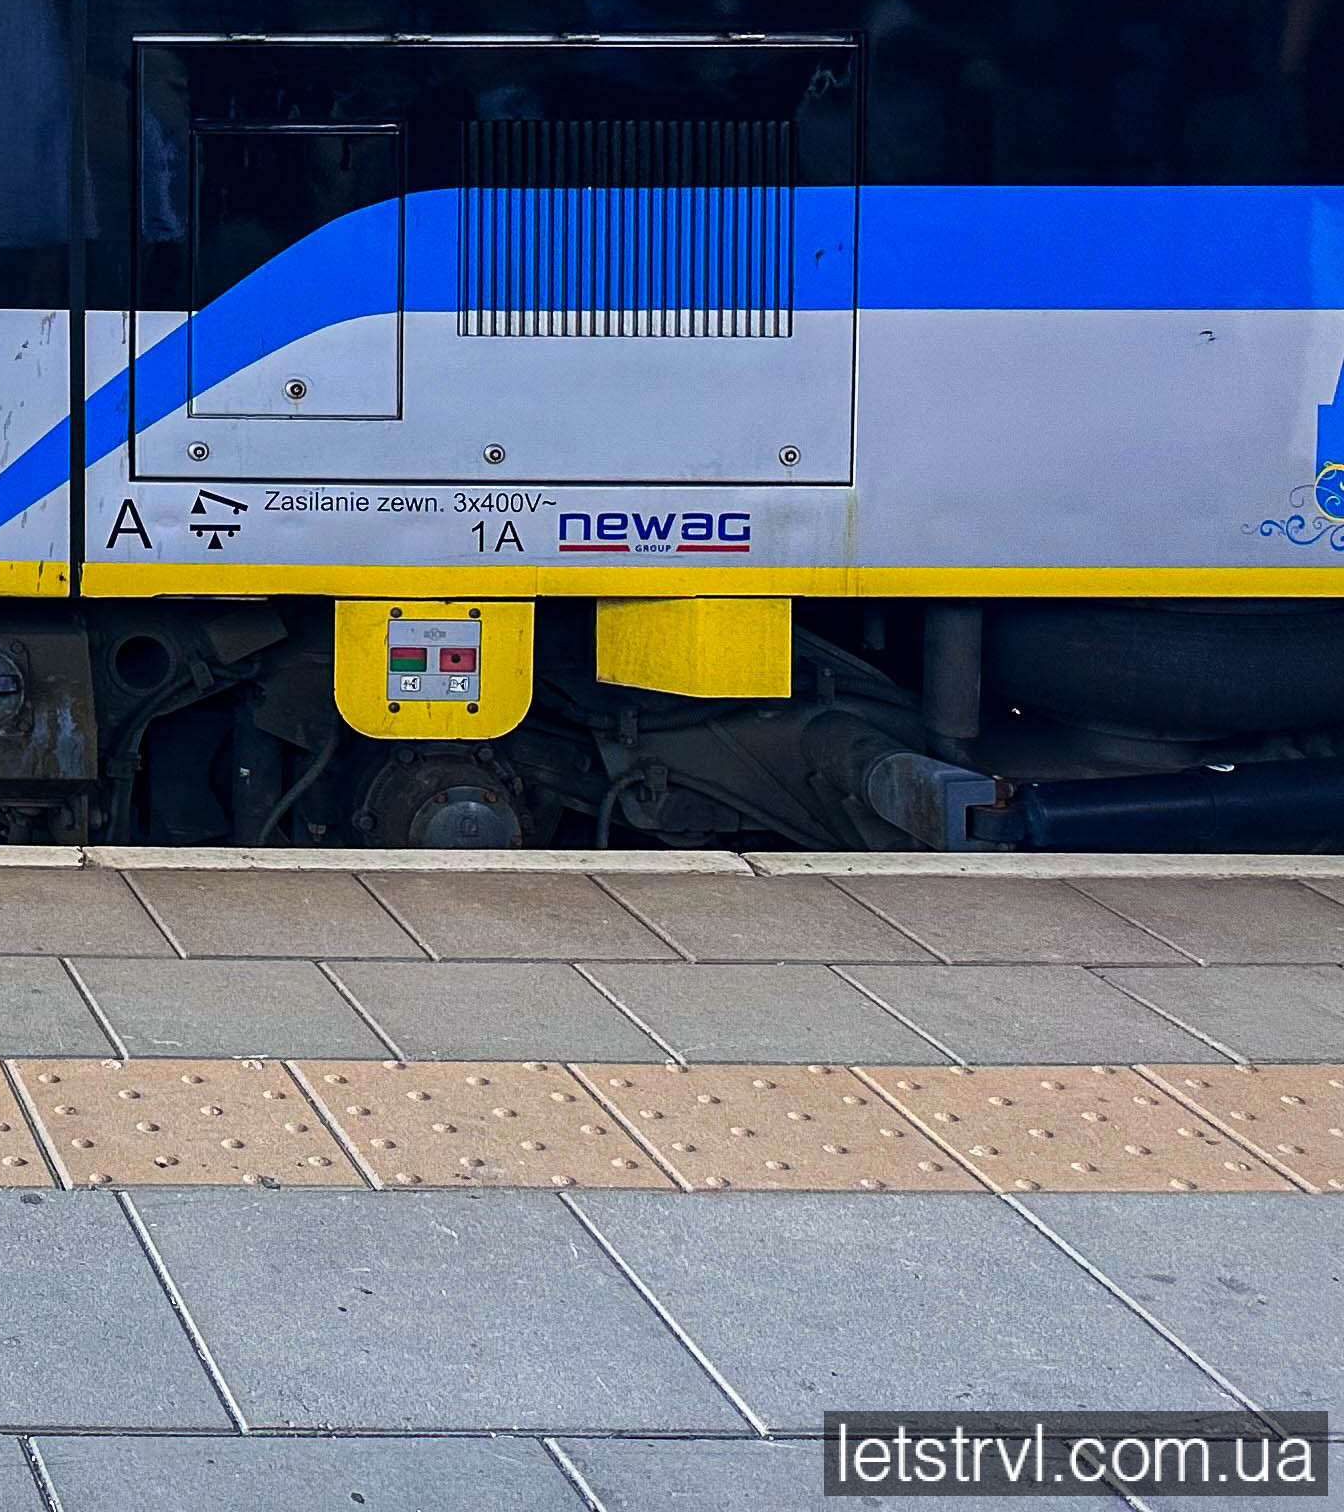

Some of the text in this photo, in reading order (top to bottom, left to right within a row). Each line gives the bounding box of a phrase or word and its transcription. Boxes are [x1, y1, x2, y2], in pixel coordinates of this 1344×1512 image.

[264, 490, 370, 512] Zasilanie
[376, 496, 445, 513] zewn.
[105, 498, 153, 549] A
[471, 520, 525, 553] 1A
[558, 512, 751, 541] newag
[634, 544, 672, 553] GROUP
